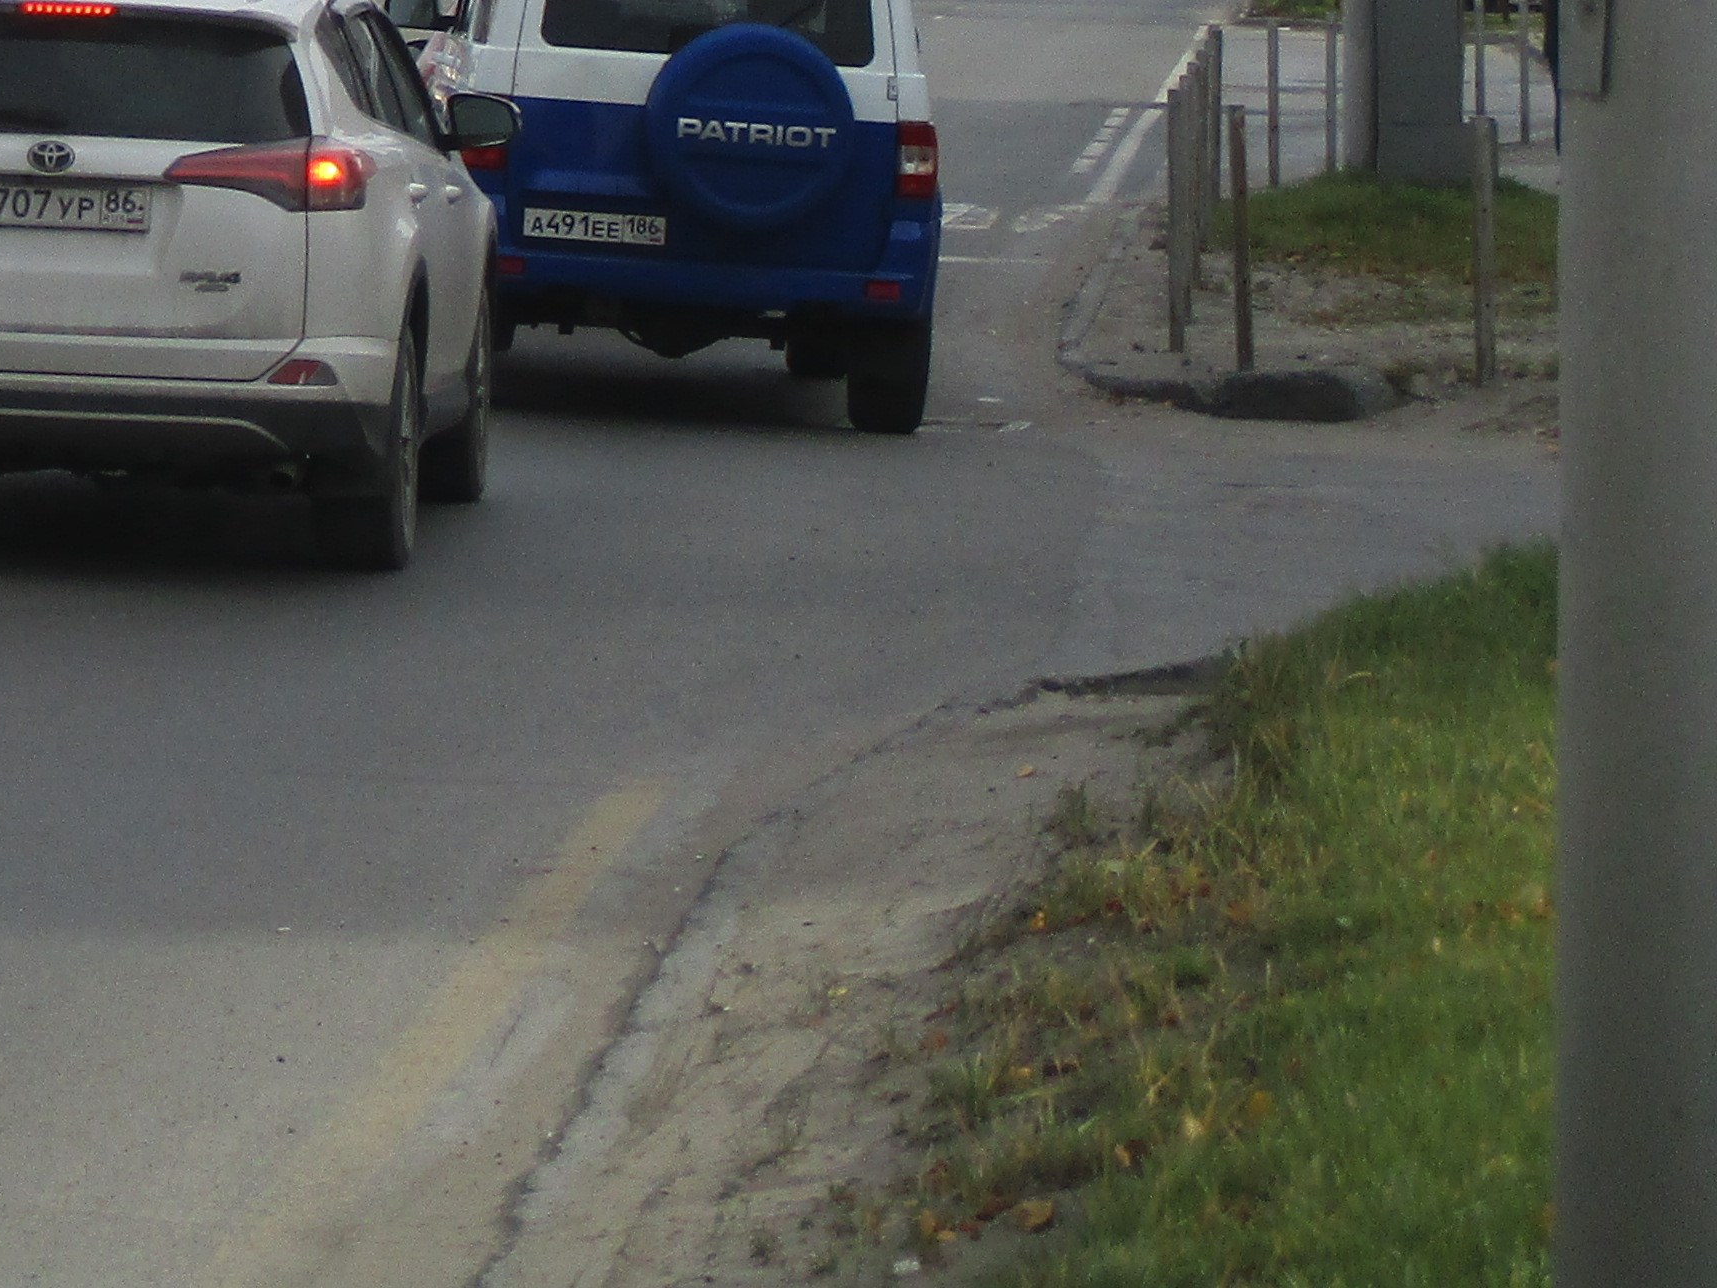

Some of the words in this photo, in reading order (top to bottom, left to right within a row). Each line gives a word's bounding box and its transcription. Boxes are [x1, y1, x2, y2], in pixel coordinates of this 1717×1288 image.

[676, 117, 837, 148] PATRIOT
[105, 190, 136, 213] 86
[628, 216, 659, 235] 186
